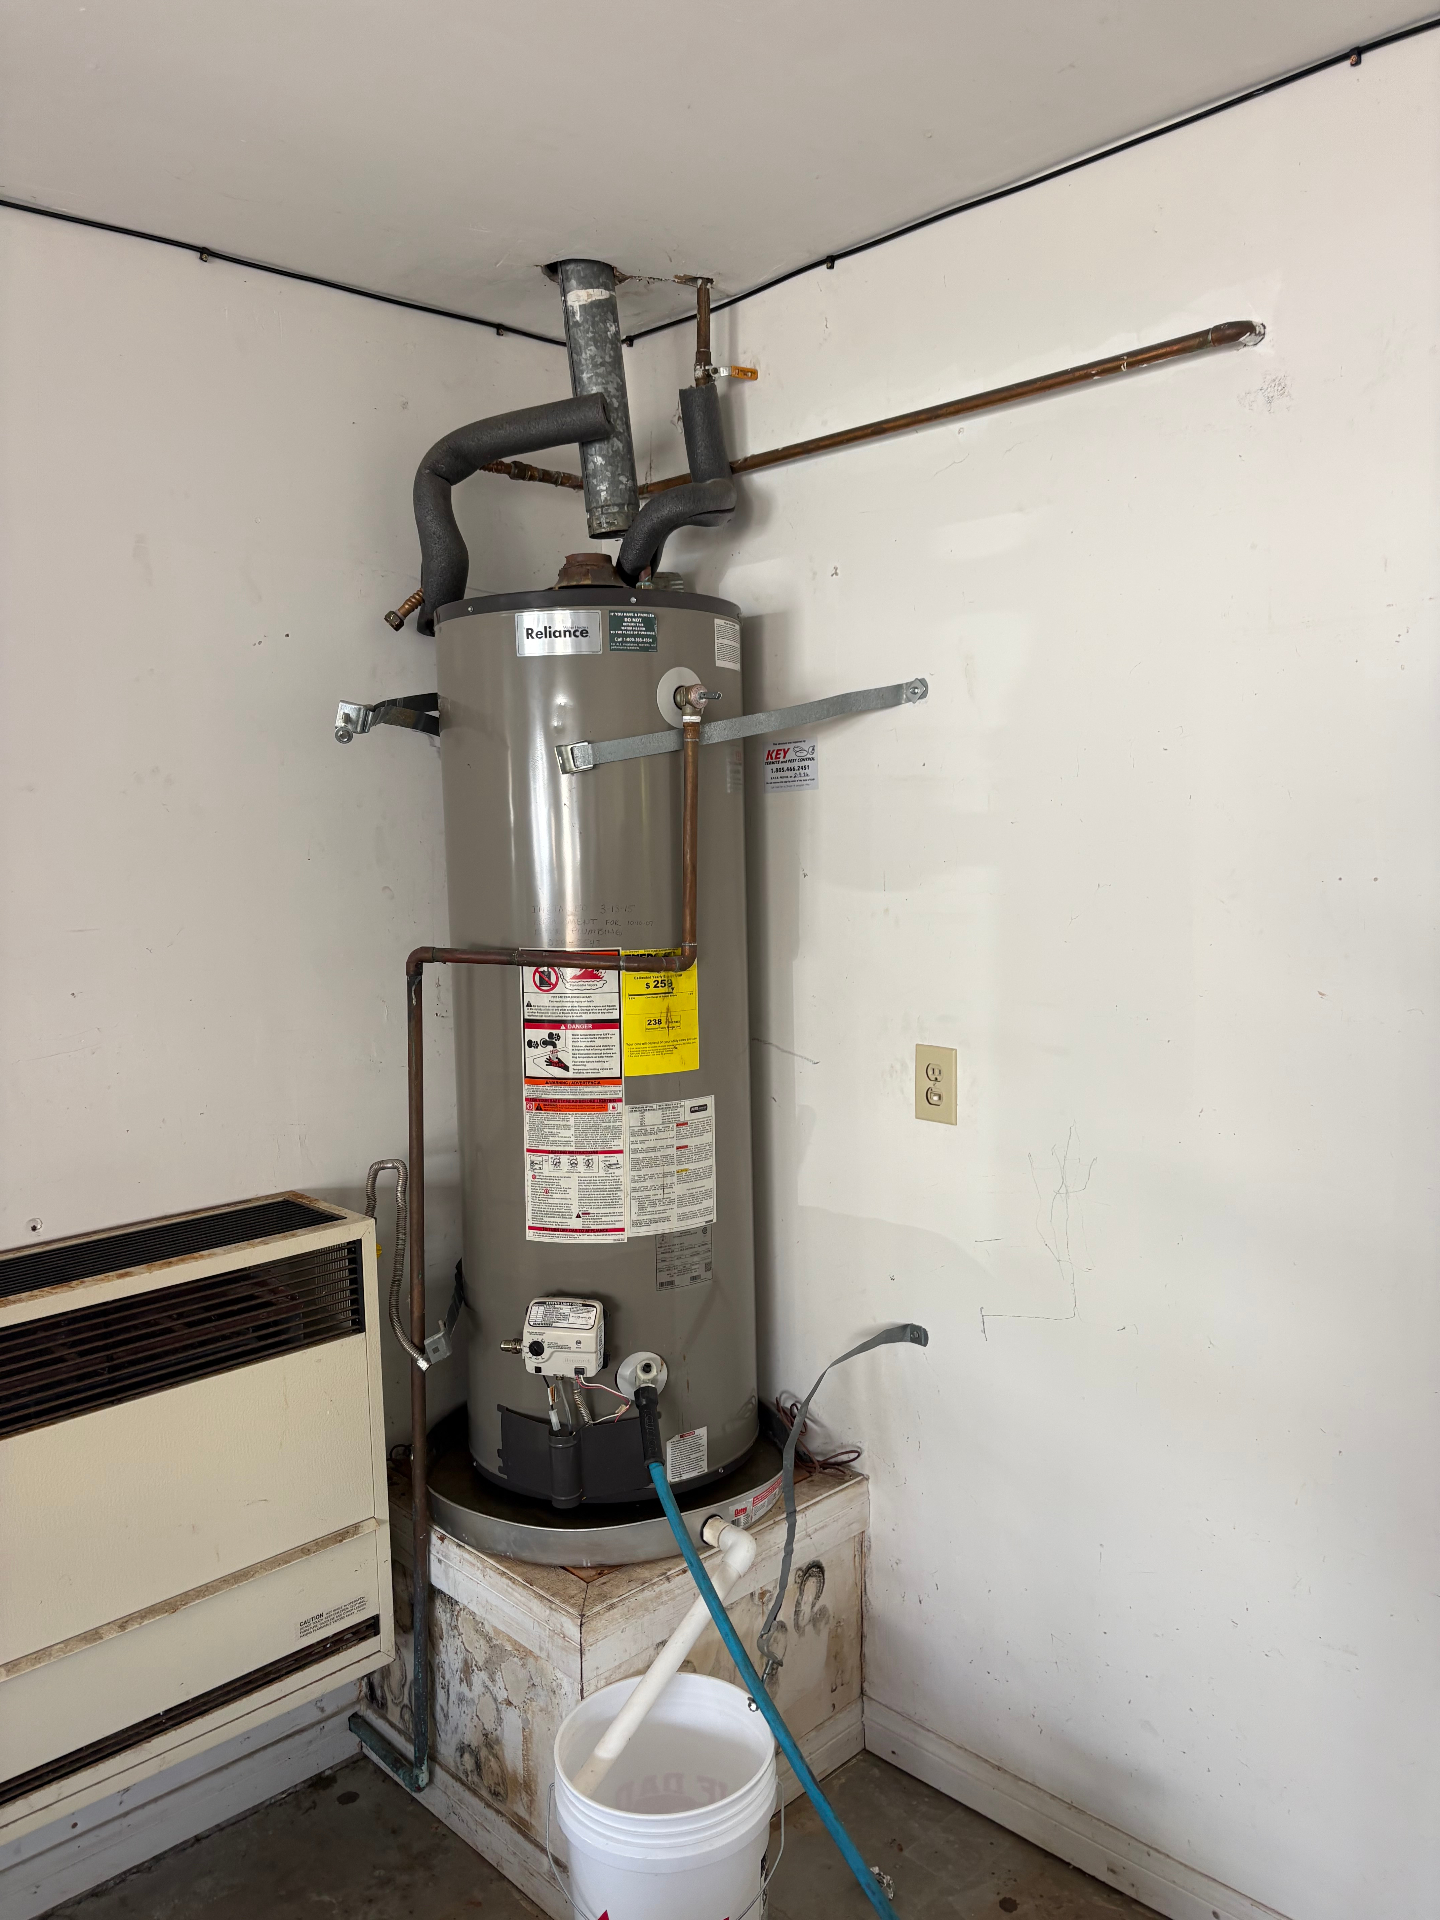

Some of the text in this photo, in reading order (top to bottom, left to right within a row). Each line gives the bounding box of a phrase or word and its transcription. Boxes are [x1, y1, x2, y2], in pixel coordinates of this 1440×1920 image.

[526, 626, 589, 640] Reliance
[766, 747, 790, 761] KEY
[300, 1612, 323, 1626] CAUTION
